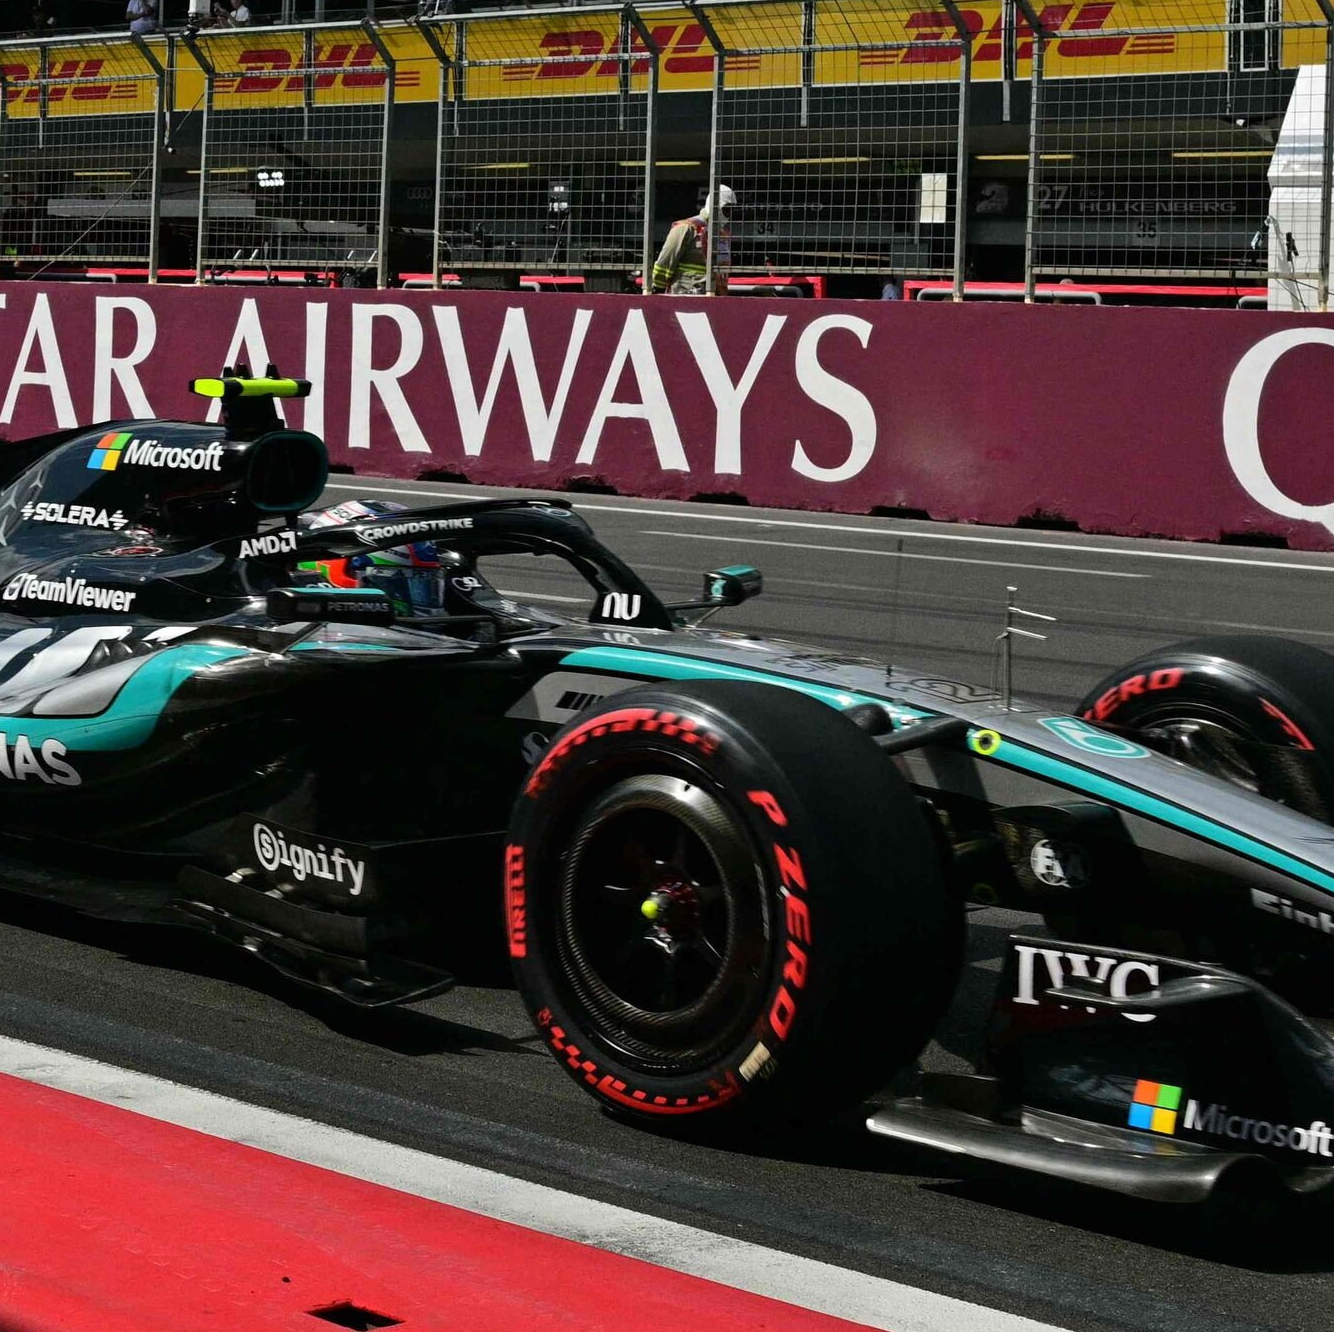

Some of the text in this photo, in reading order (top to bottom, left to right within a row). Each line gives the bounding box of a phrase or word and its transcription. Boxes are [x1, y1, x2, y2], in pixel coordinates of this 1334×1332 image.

[530, 24, 721, 79] DHL
[898, 2, 1130, 63] DHL
[234, 44, 389, 93] DHL
[1136, 222, 1157, 238] 35
[205, 297, 877, 483] AIRWAYS
[123, 439, 224, 472] Microsoft
[35, 502, 110, 528] SOLERA
[362, 517, 474, 541] CROWDSTRIKE
[239, 530, 297, 559] AMD
[21, 574, 137, 613] TeamViewer
[327, 601, 390, 612] PETRONAS
[1084, 669, 1184, 721] ERO
[747, 789, 812, 1041] P ZERO
[1013, 944, 1160, 1022] IWC
